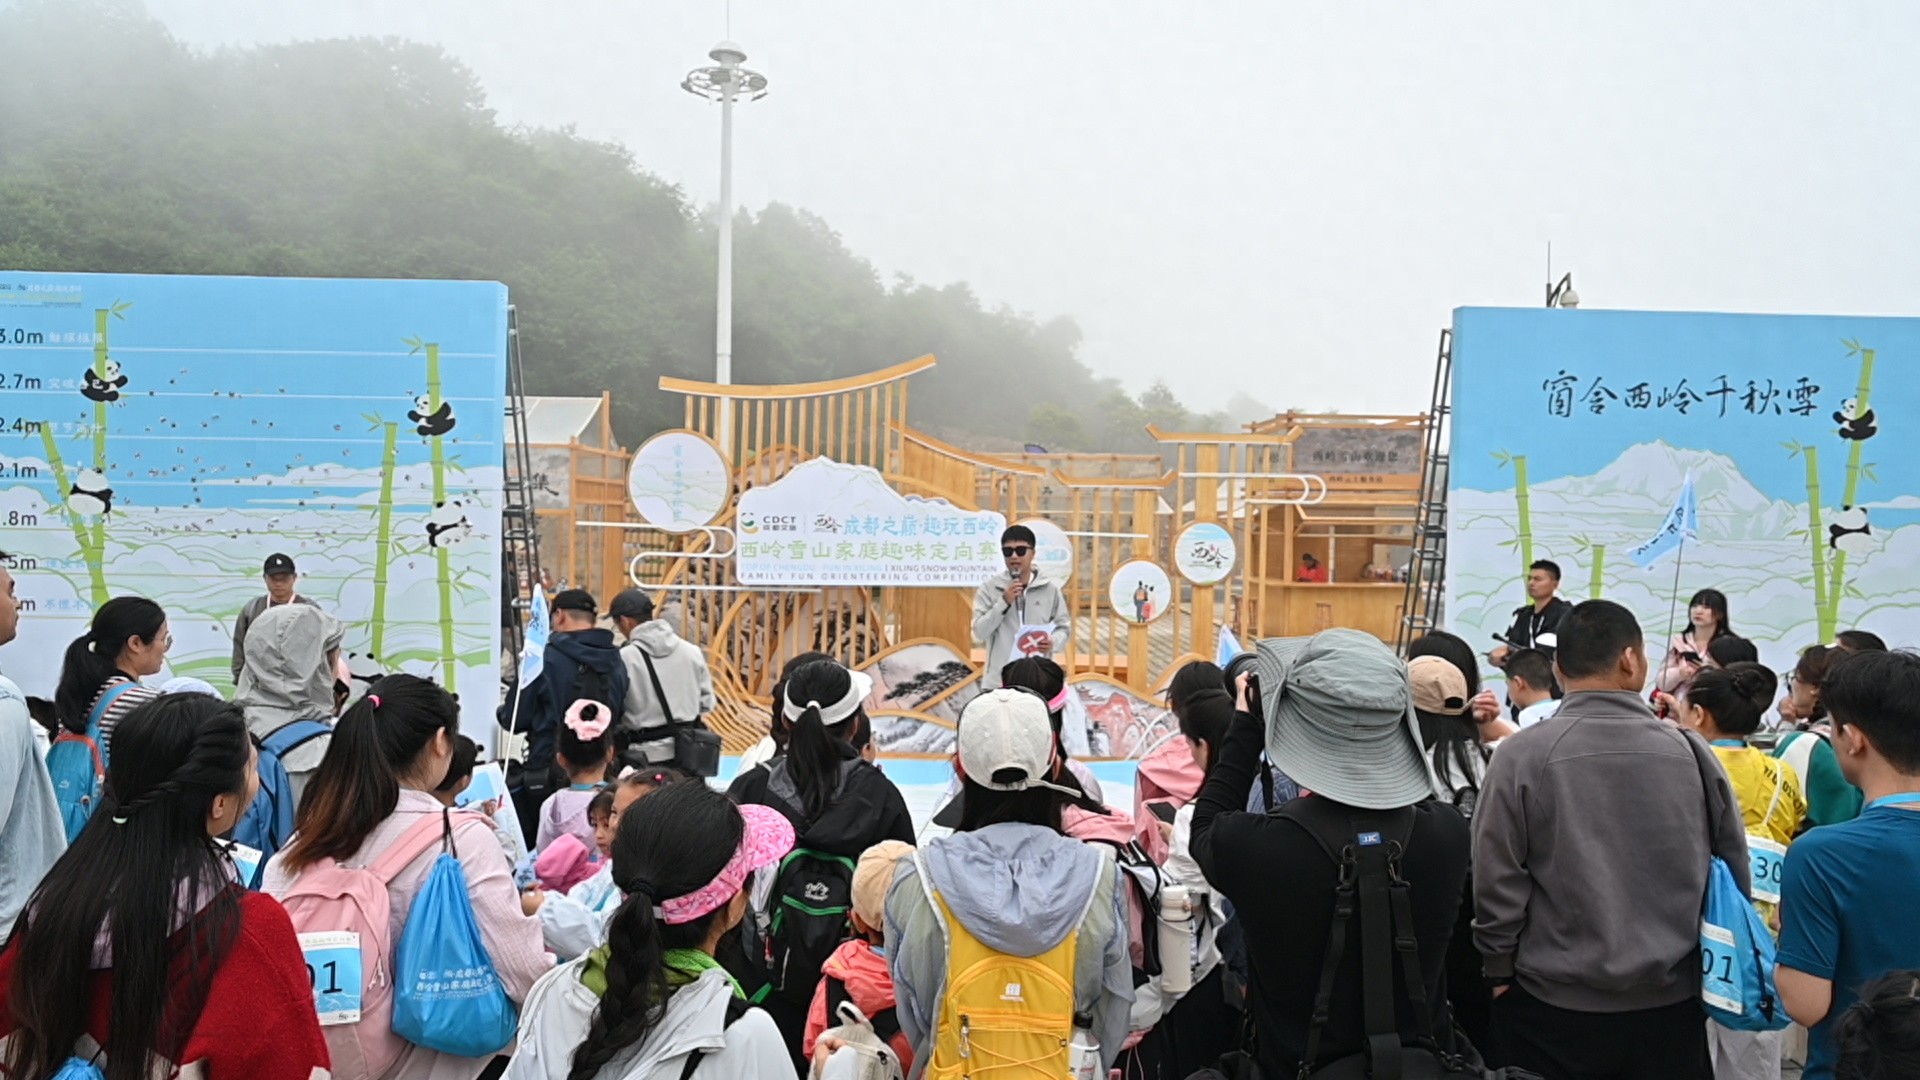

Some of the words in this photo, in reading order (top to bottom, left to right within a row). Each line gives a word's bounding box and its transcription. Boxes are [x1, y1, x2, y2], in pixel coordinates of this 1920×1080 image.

[741, 572, 783, 580] FAMILY
[791, 572, 813, 580] FUN
[821, 573, 908, 581] ORIENTEERING
